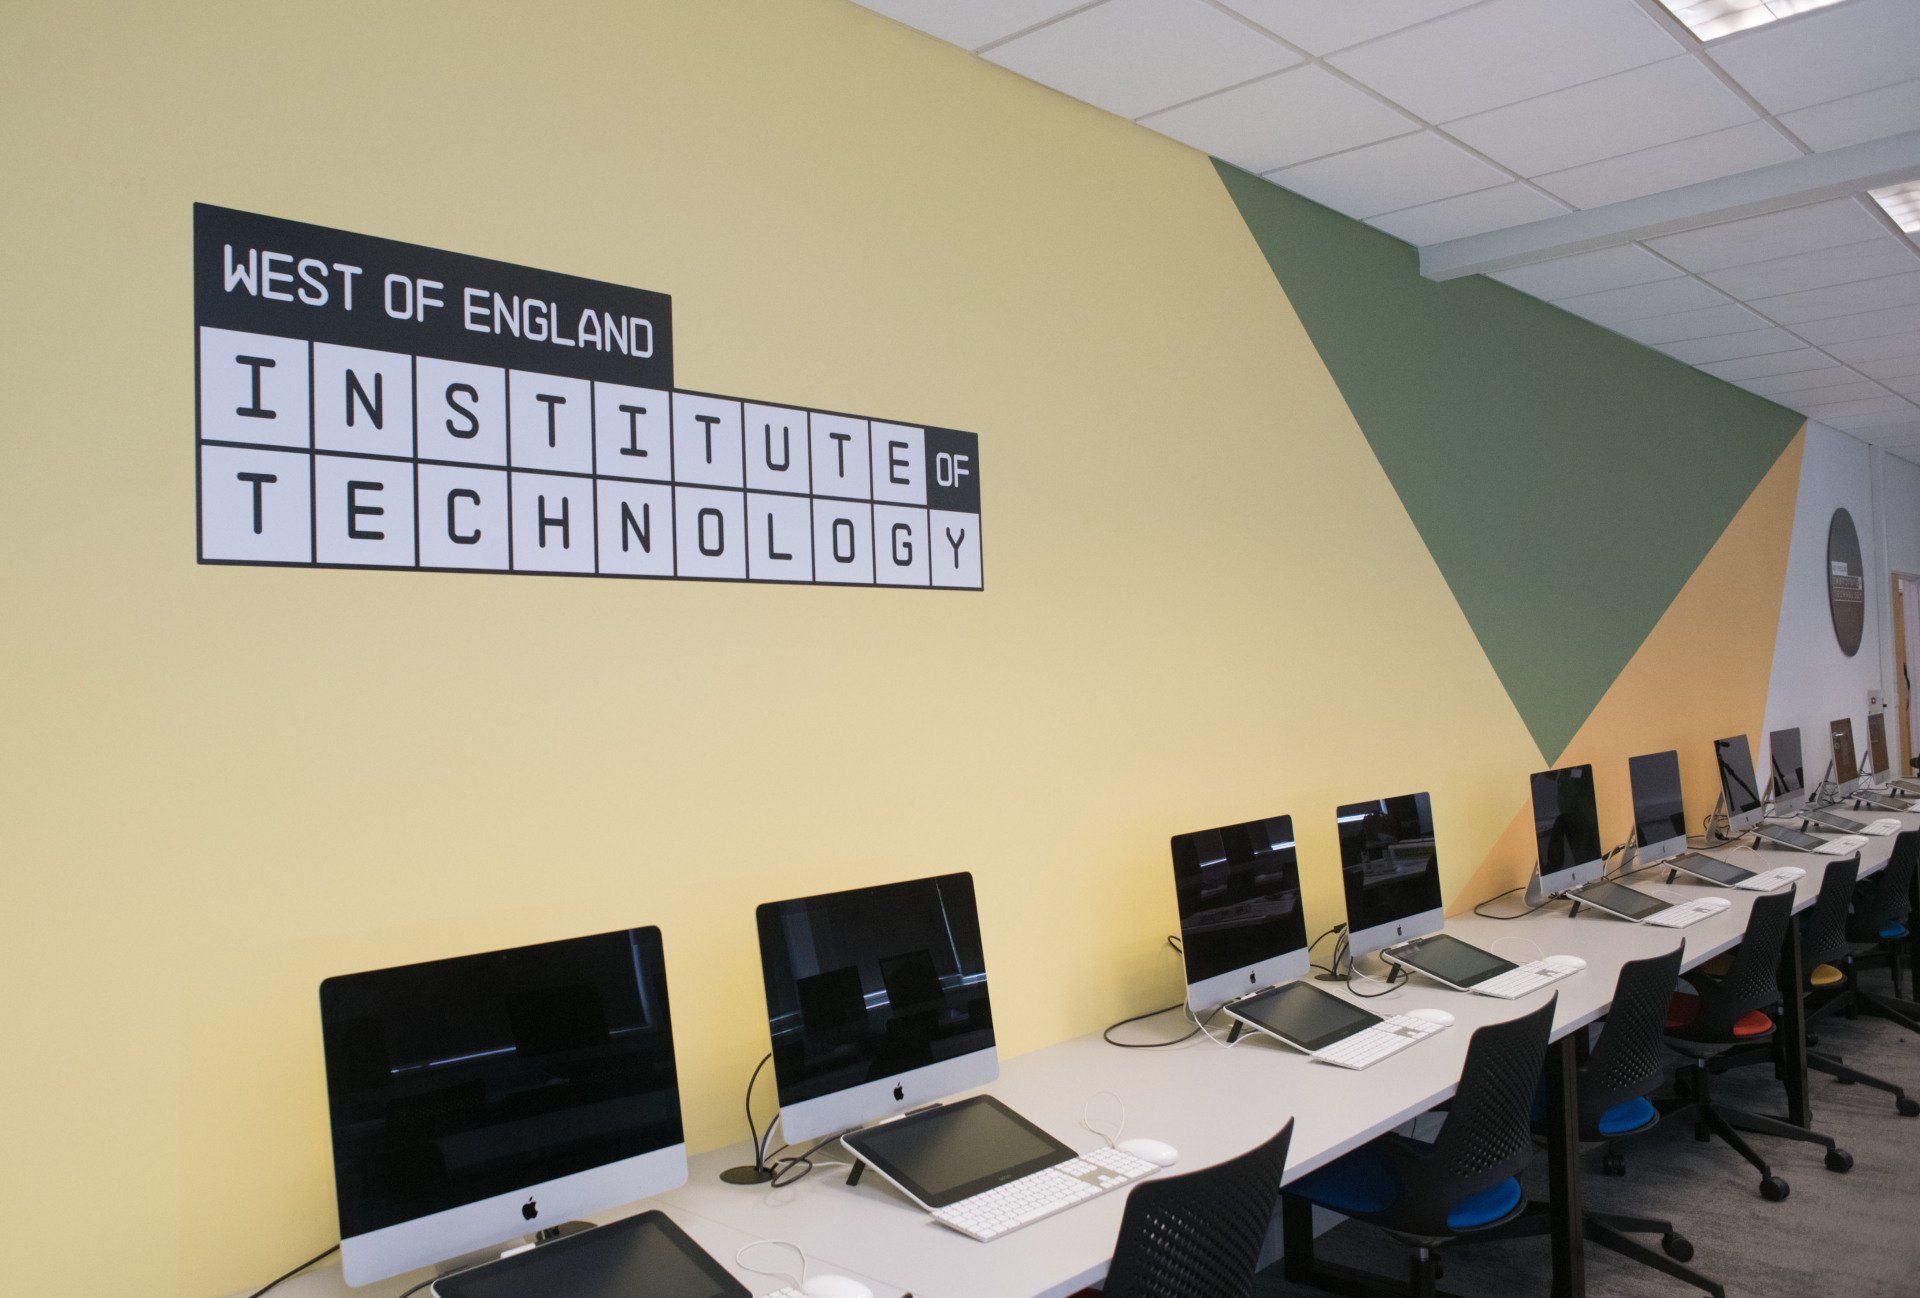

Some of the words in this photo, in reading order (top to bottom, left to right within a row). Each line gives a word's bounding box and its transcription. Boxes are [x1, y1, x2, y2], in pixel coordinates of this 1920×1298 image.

[223, 243, 362, 311] WEST
[384, 273, 444, 322] OF
[464, 286, 654, 359] ENGLAND
[235, 354, 910, 485] INSTITUTE
[936, 452, 970, 488] OF
[236, 471, 966, 569] TECHNOLOGY
